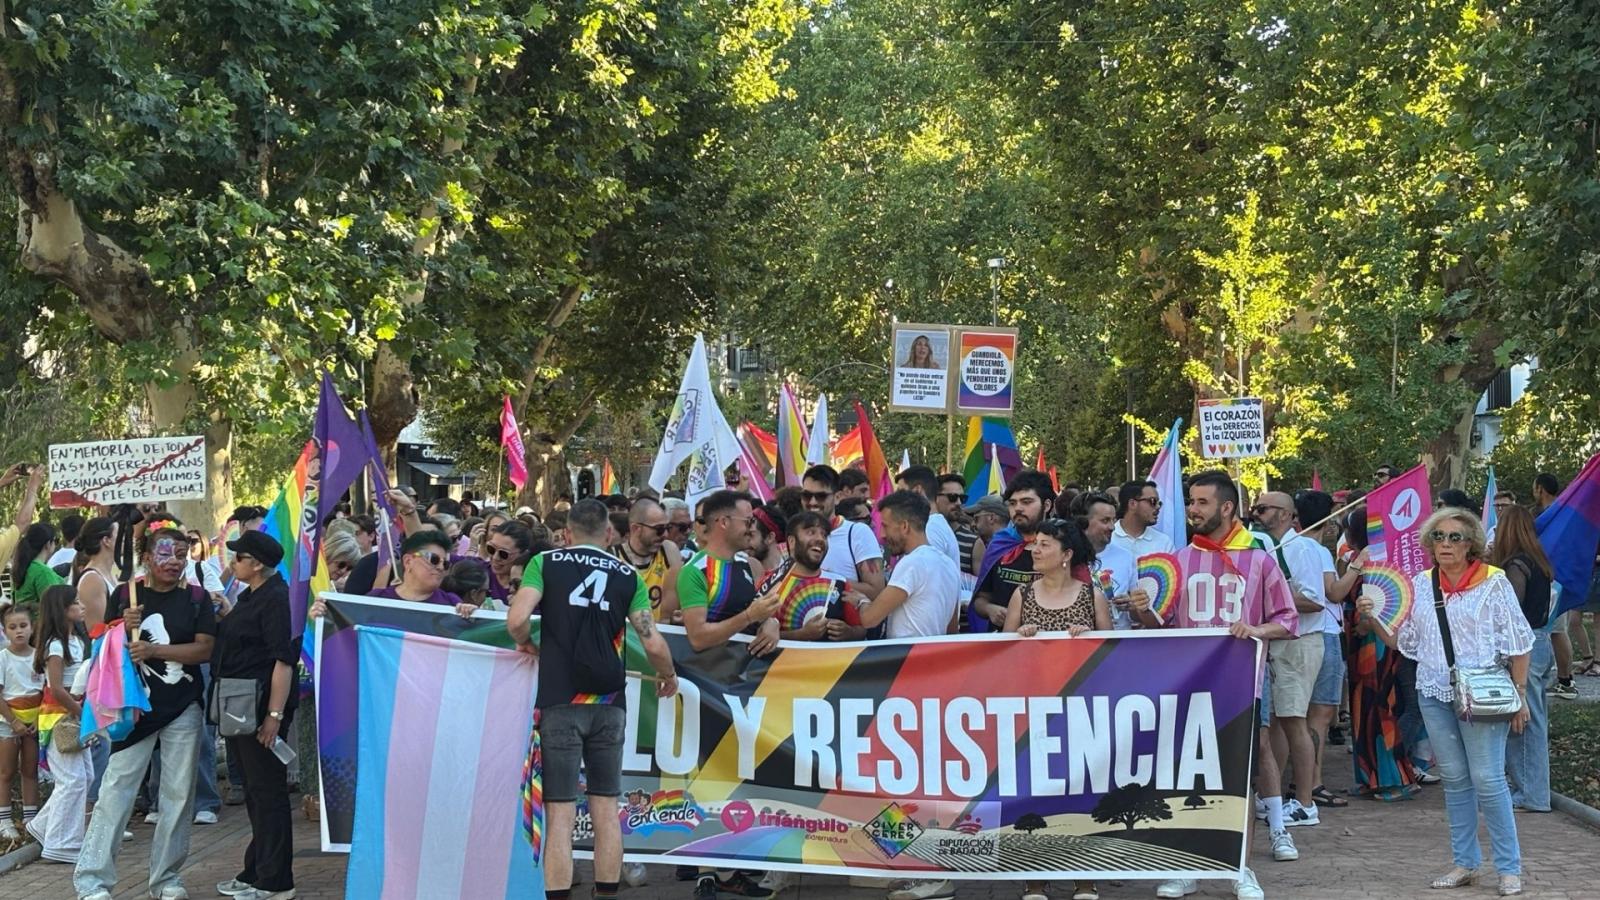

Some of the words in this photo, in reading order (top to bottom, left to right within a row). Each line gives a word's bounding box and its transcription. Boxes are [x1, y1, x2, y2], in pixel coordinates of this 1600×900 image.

[970, 359, 1004, 367] MERECEMOS
[966, 366, 980, 374] MÁS
[966, 375, 998, 383] PENDIENTES
[1204, 412, 1212, 421] El
[1215, 406, 1260, 421] CORAZÓN
[1223, 422, 1260, 430] DERECHOS:
[1222, 430, 1261, 440] IZQUIERDA
[50, 448, 68, 460] EN
[74, 444, 132, 458] MEMORIA
[144, 444, 162, 453] DE
[133, 473, 201, 484] SEGUIMOS
[102, 490, 126, 501] PIE
[132, 488, 149, 498] DE
[159, 482, 203, 496] LUCHA!
[568, 570, 610, 611] 4
[1188, 573, 1246, 623] 03
[622, 676, 700, 776] LO
[722, 693, 767, 781] Y
[793, 691, 1223, 798] RESISTENCIA
[759, 812, 849, 834] triángulo
[872, 821, 914, 831] DIVER
[872, 830, 914, 839] CERES
[940, 836, 994, 848] DIPUTACIÓN
[950, 847, 993, 856] BADAJOZ
